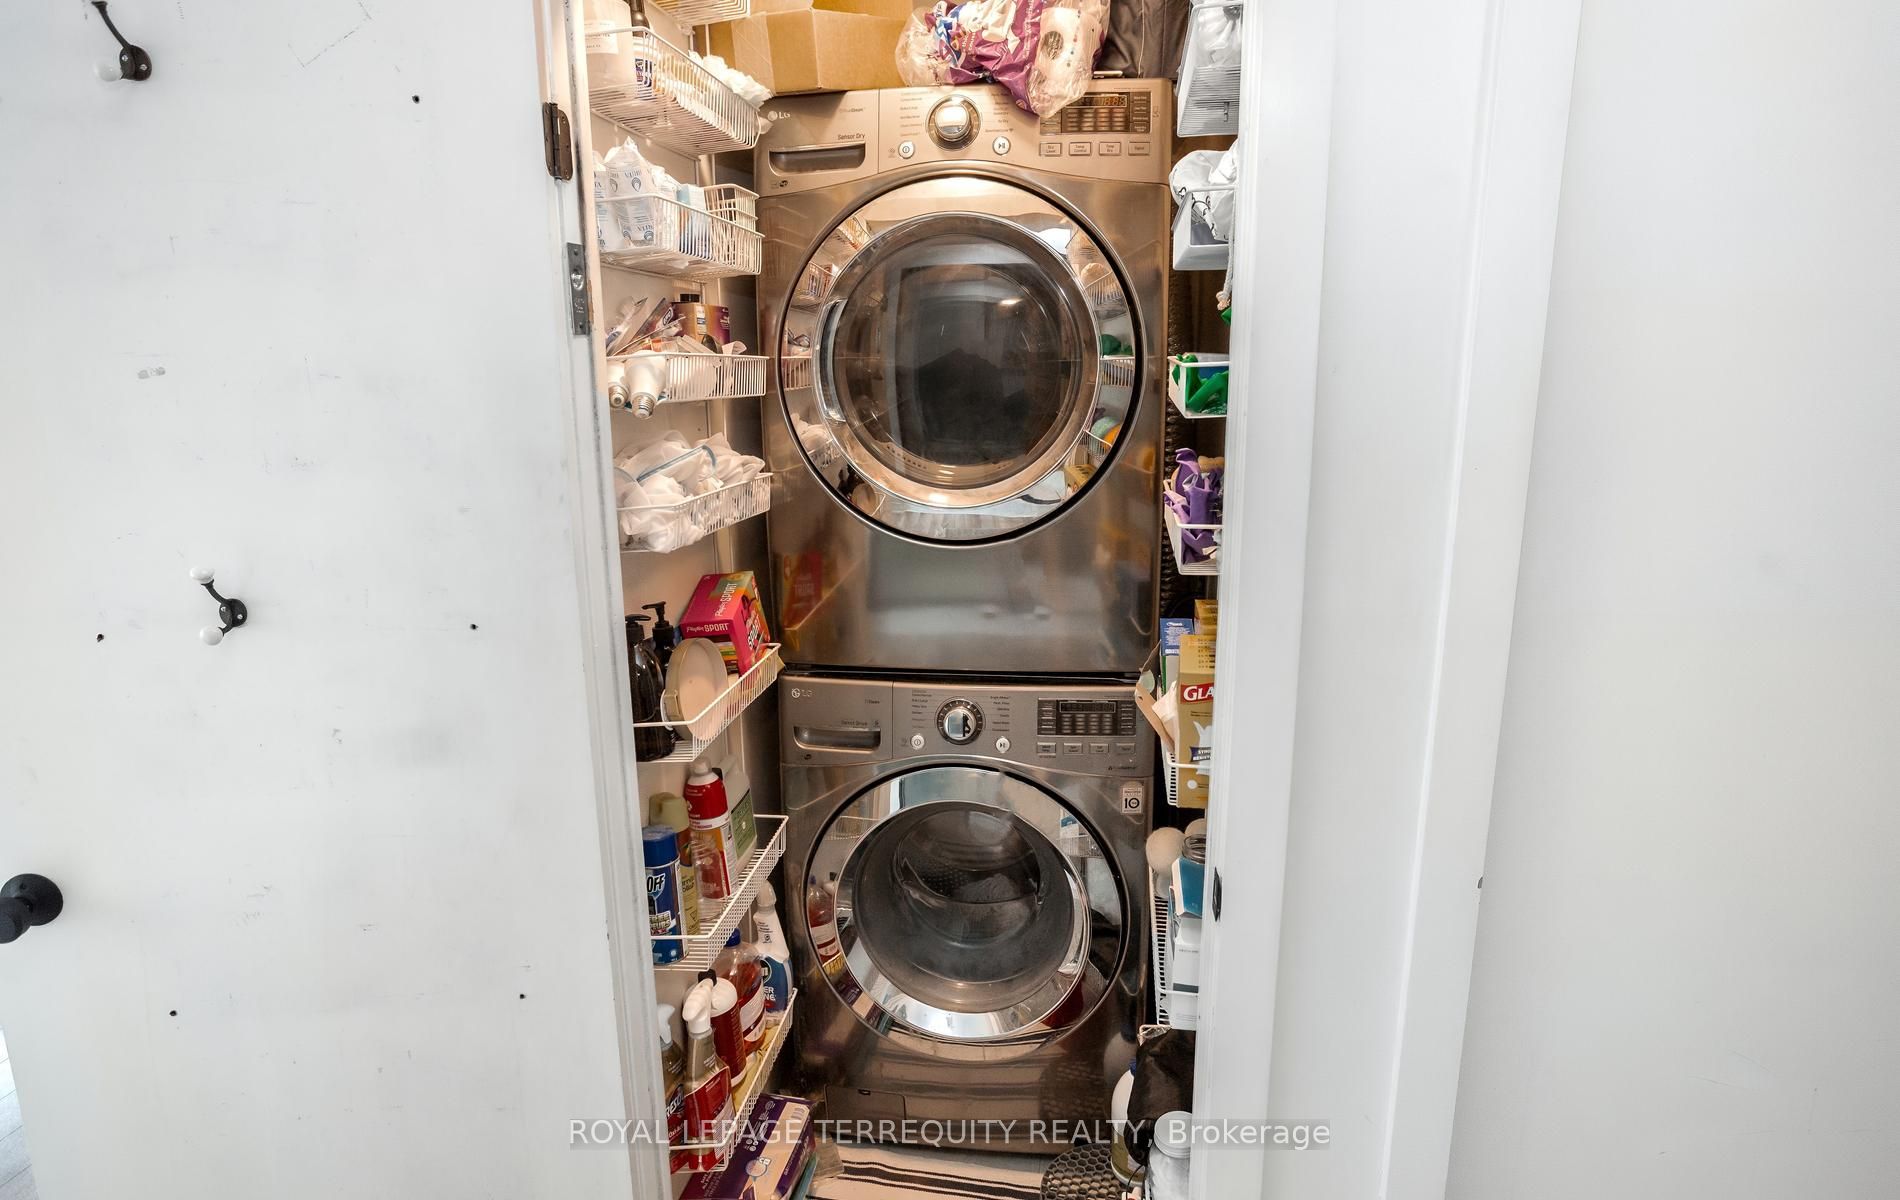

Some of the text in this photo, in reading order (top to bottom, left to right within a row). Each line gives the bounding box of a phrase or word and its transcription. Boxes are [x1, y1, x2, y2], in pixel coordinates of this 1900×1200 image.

[778, 111, 791, 119] LG
[856, 132, 866, 140] Dry
[720, 583, 738, 602] SPORT
[704, 622, 730, 633] SPORT
[646, 873, 665, 893] OFF
